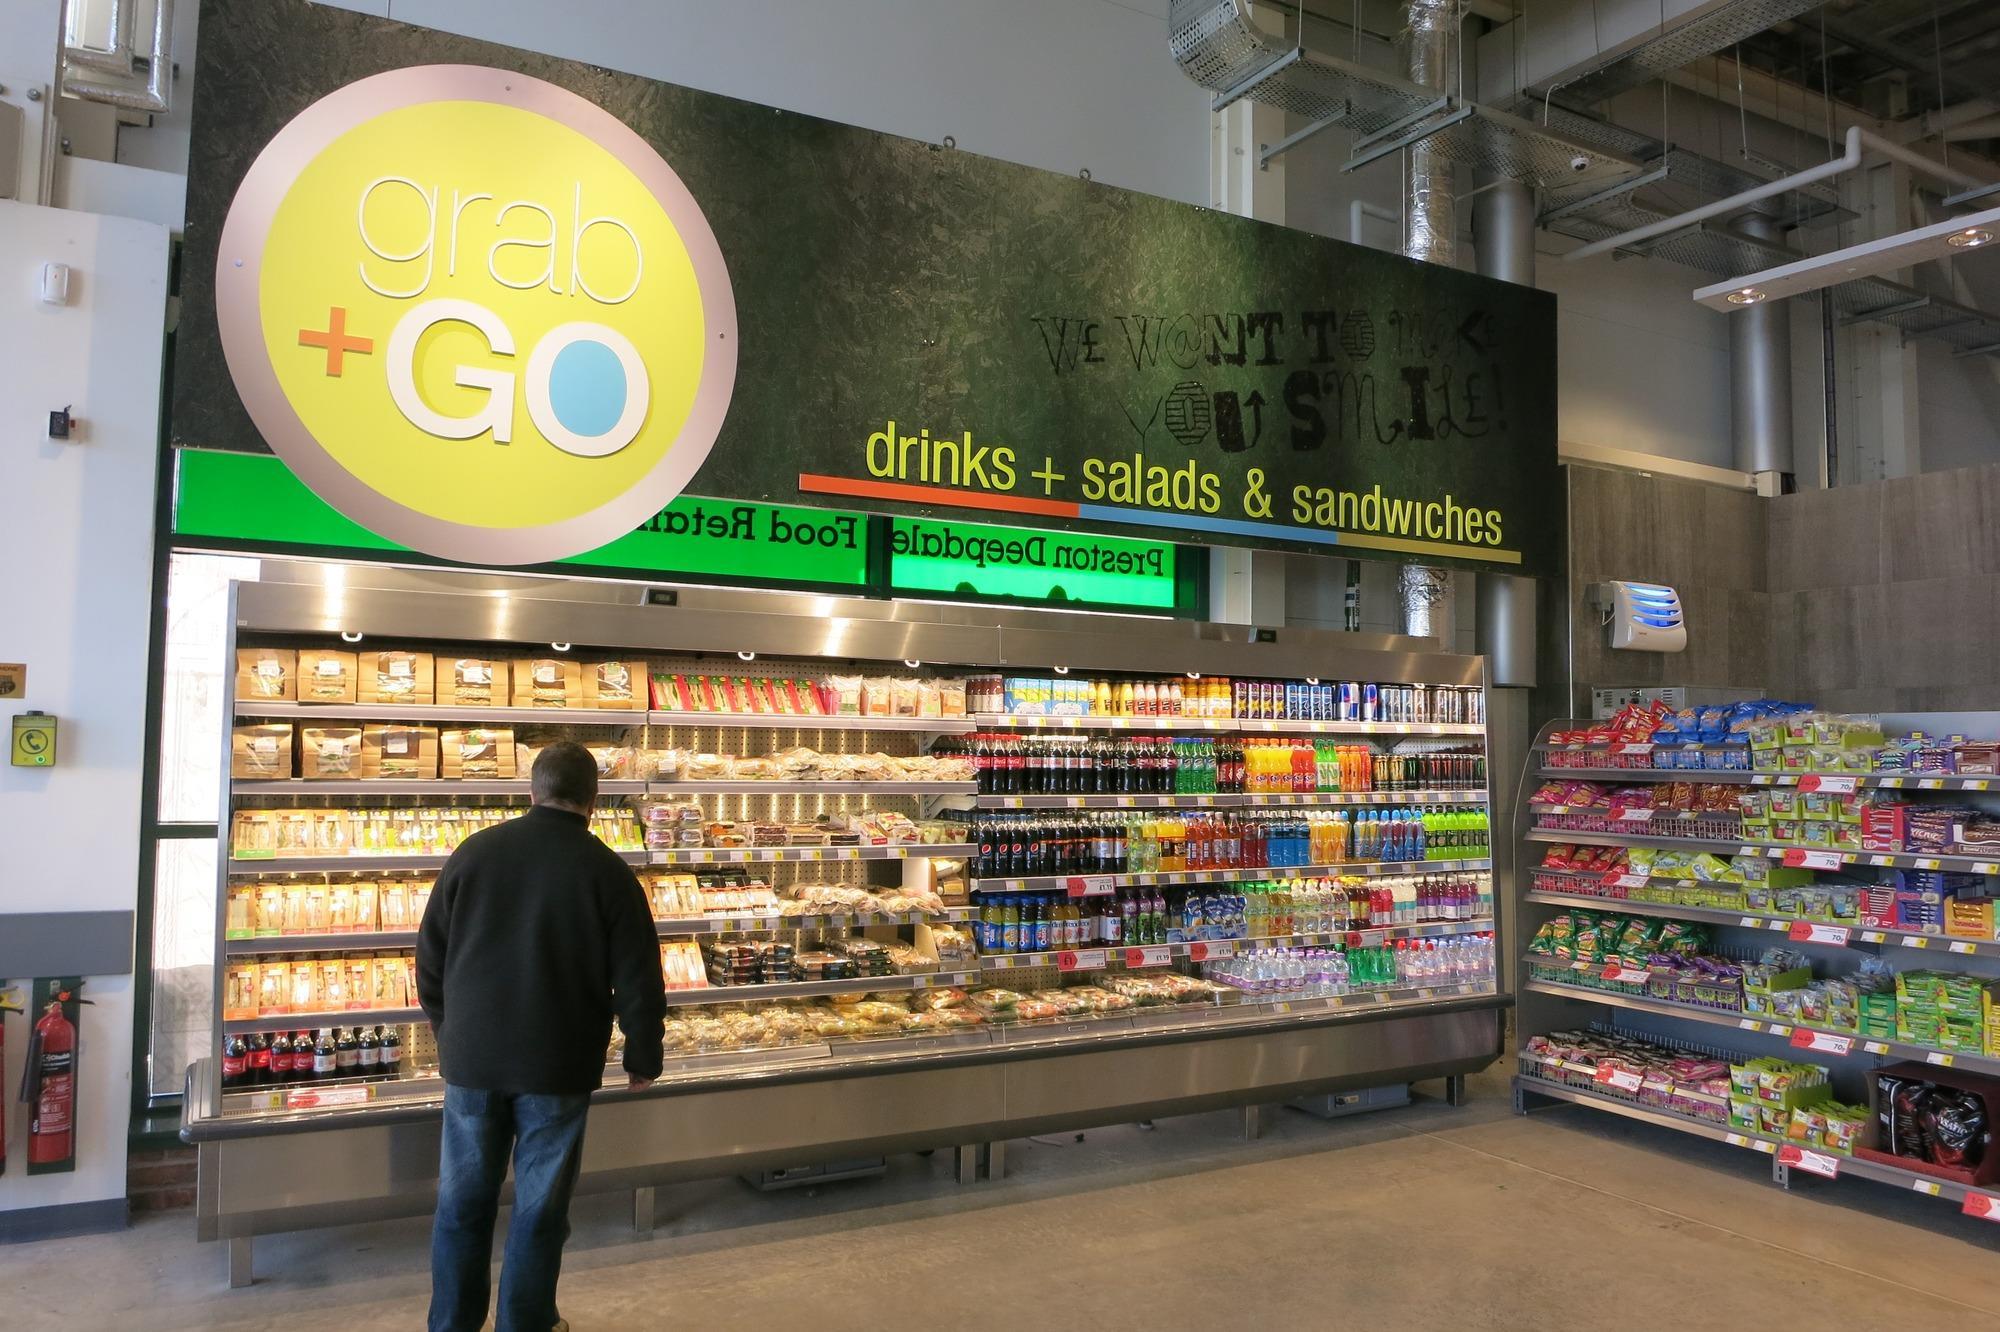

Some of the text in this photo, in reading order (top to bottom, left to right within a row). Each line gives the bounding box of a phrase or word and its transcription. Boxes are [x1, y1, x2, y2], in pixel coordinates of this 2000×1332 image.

[357, 174, 644, 306] grab
[1300, 309, 1376, 366] TO
[1118, 379, 1267, 458] YOU
[866, 421, 1016, 492] drinks
[1082, 453, 1221, 514] salads
[1243, 468, 1273, 519] &
[1293, 484, 1503, 545] sandwiches
